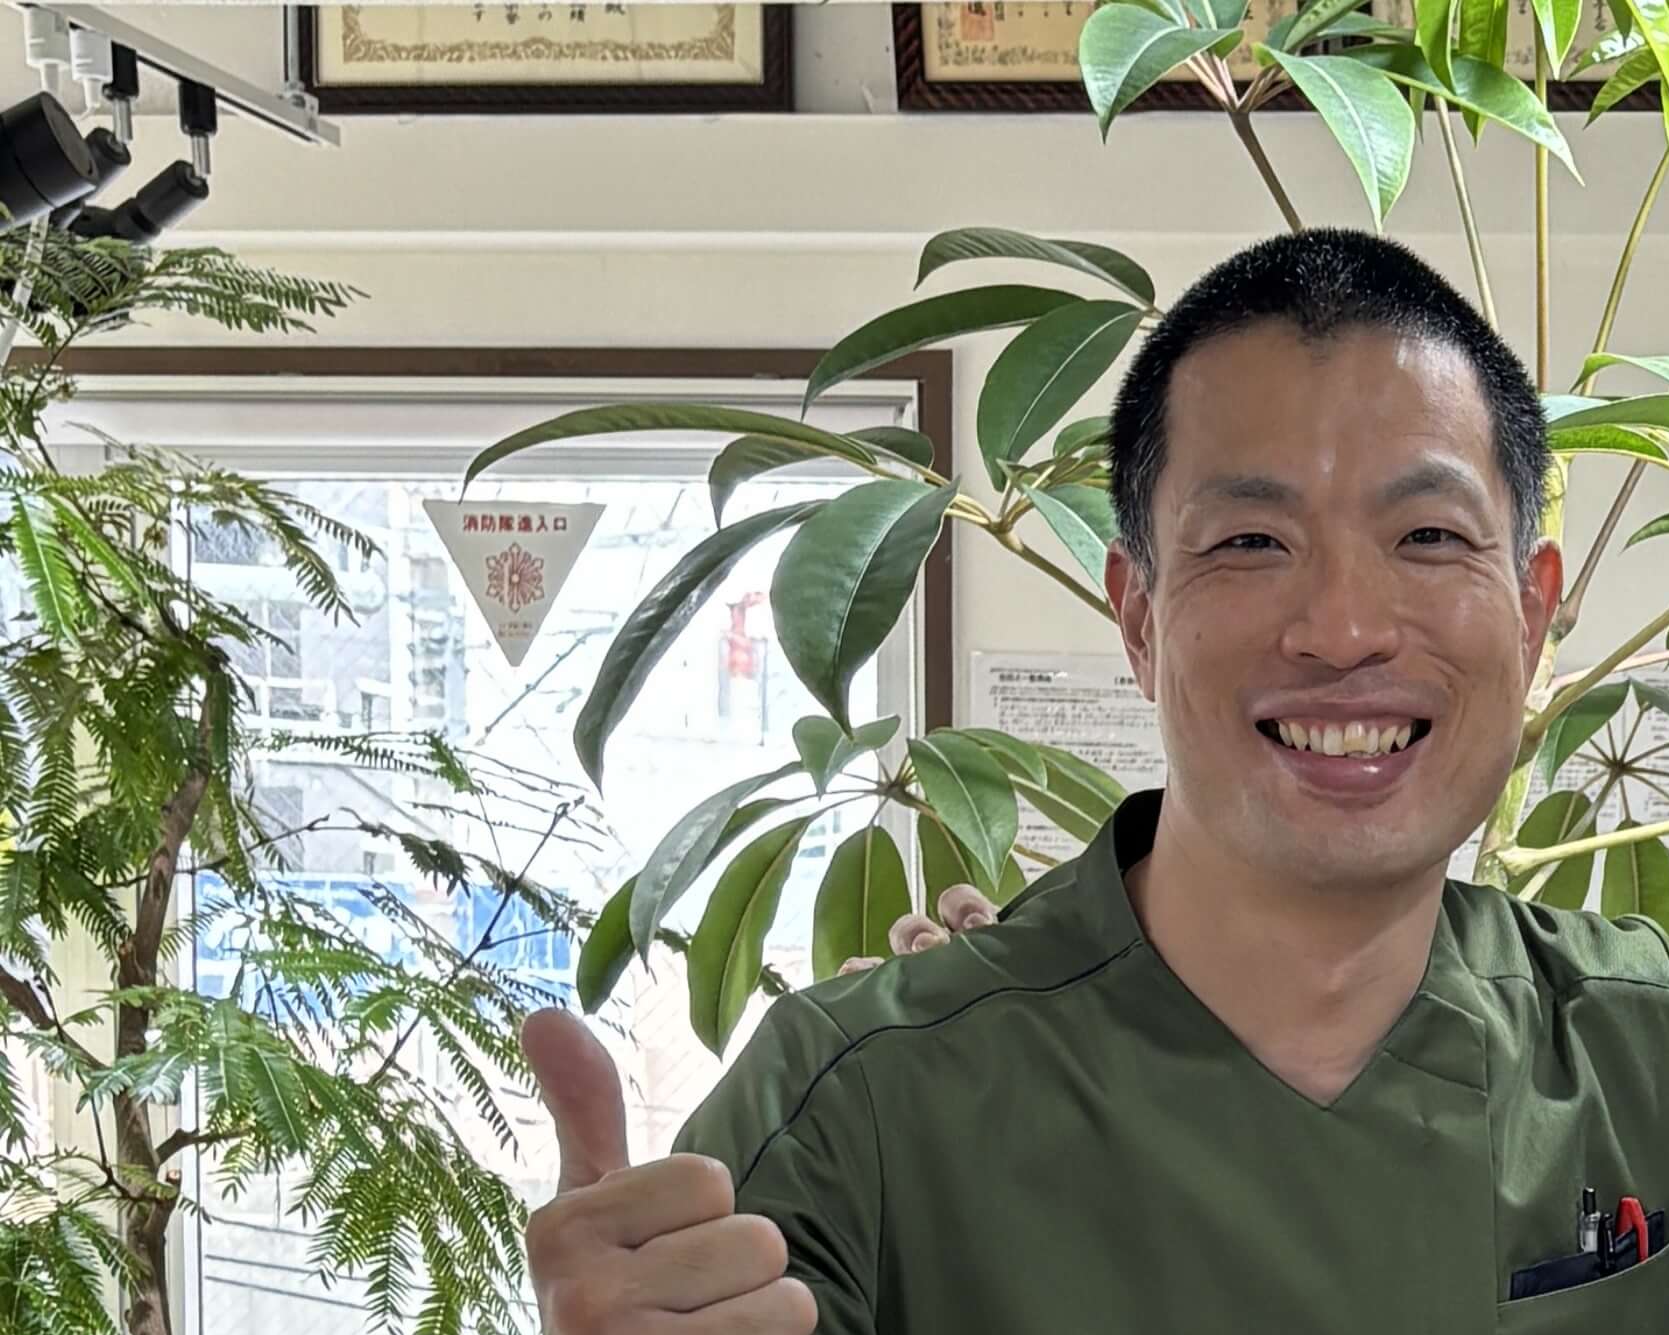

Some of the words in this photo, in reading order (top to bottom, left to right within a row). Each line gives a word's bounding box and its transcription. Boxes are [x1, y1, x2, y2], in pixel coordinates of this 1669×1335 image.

[463, 514, 567, 532] 消防隊進入口
